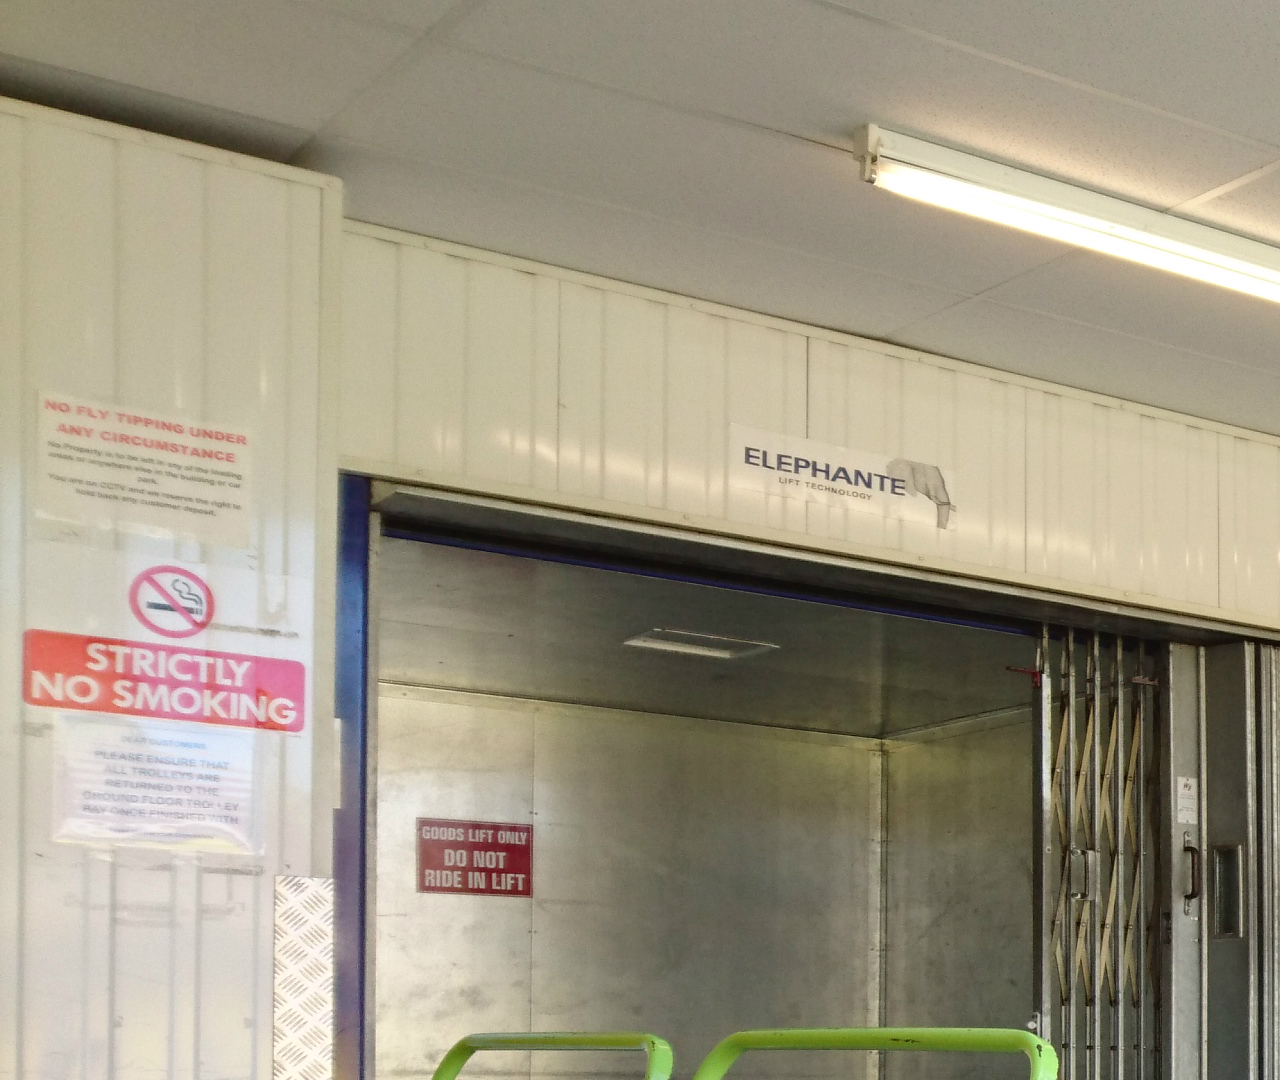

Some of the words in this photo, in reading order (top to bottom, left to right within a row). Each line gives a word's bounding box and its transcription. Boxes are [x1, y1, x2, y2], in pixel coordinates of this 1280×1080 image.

[44, 399, 70, 413] NO
[76, 405, 109, 420] FLY
[115, 412, 185, 434] TIPPING
[190, 427, 247, 445] UNDER
[56, 423, 94, 438] ANY
[100, 430, 236, 463] CIRCUMSTANCE
[47, 440, 61, 449] No
[64, 443, 102, 457] Property
[196, 466, 208, 474] the
[166, 470, 178, 479] the
[180, 474, 215, 486] building
[744, 446, 906, 496] ELEPHANTE
[778, 477, 801, 487] LIFT
[804, 481, 873, 500] TECHNOLOGY
[85, 642, 251, 687] STRICTLY
[30, 670, 99, 703] NO
[112, 679, 297, 725] SMOKING
[146, 754, 197, 768] ENSURE
[199, 759, 230, 770] THAT
[104, 778, 174, 793] RETURNED
[177, 784, 193, 794] TO
[196, 786, 220, 797] THE
[422, 825, 464, 842] GOODS
[468, 828, 494, 843] LIFT
[497, 830, 528, 845] ONLY
[443, 848, 467, 867] DO
[473, 850, 507, 869] NOT
[424, 869, 462, 888] RIDE
[468, 871, 486, 889] IN
[491, 872, 526, 891] LIFT
